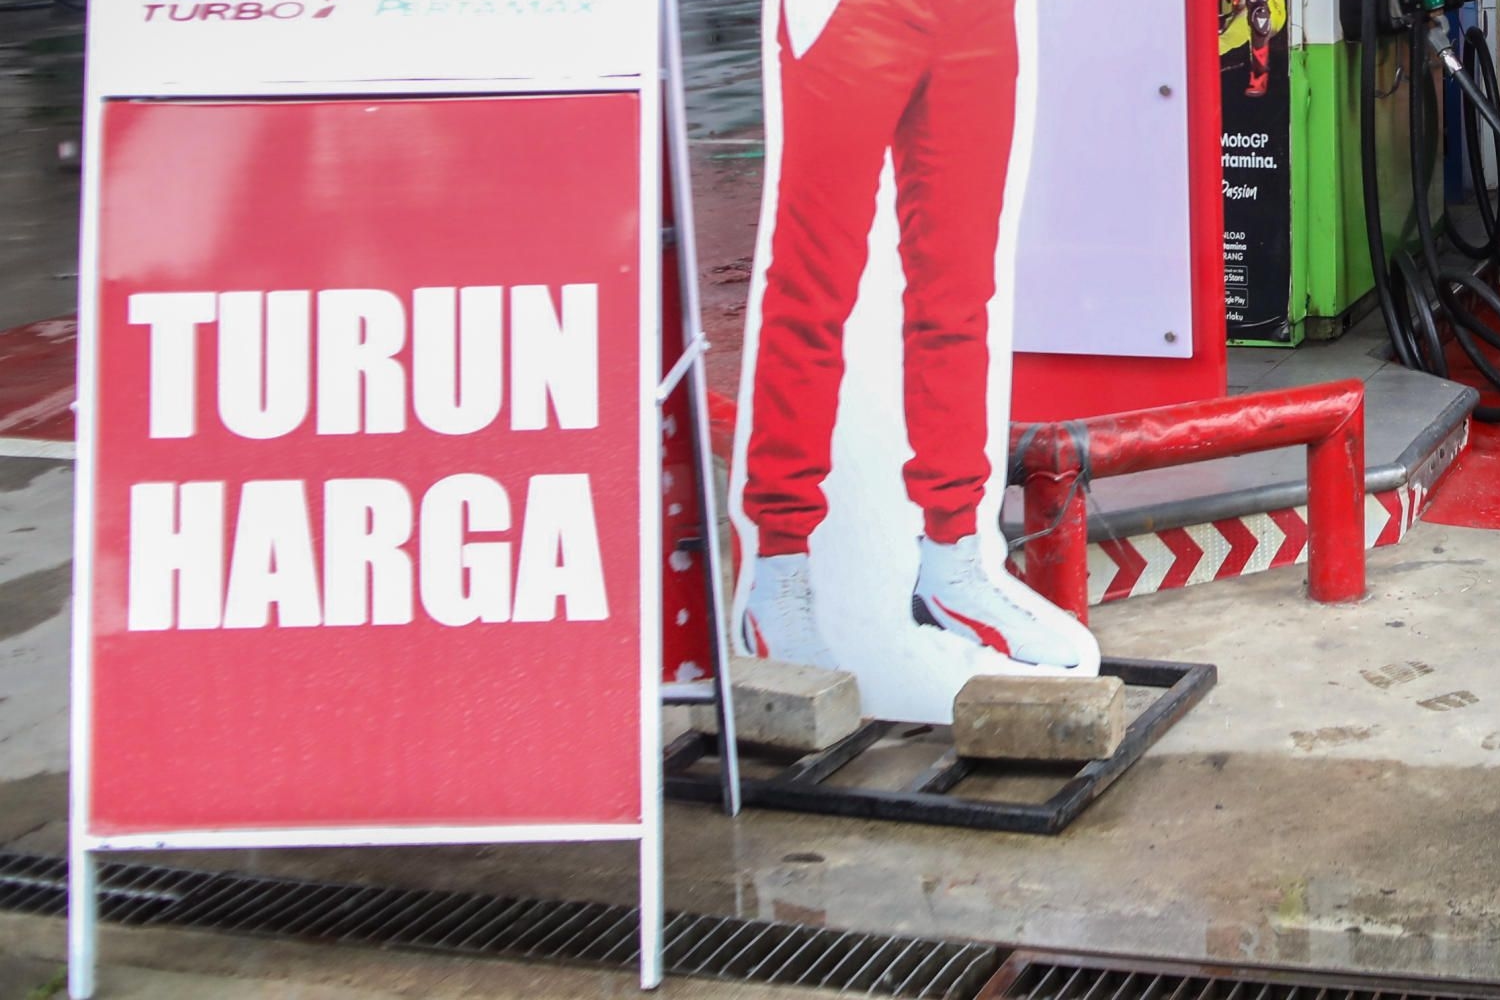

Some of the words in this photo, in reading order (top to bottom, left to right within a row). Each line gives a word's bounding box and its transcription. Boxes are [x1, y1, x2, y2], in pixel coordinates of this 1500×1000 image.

[143, 1, 305, 22] TURBO
[1220, 132, 1269, 148] MotoGP
[1221, 152, 1277, 169] rtamina.
[1223, 241, 1247, 250] tamina
[1226, 311, 1244, 321] rlaku
[127, 283, 600, 440] TURUN
[127, 473, 611, 632] HARGA
